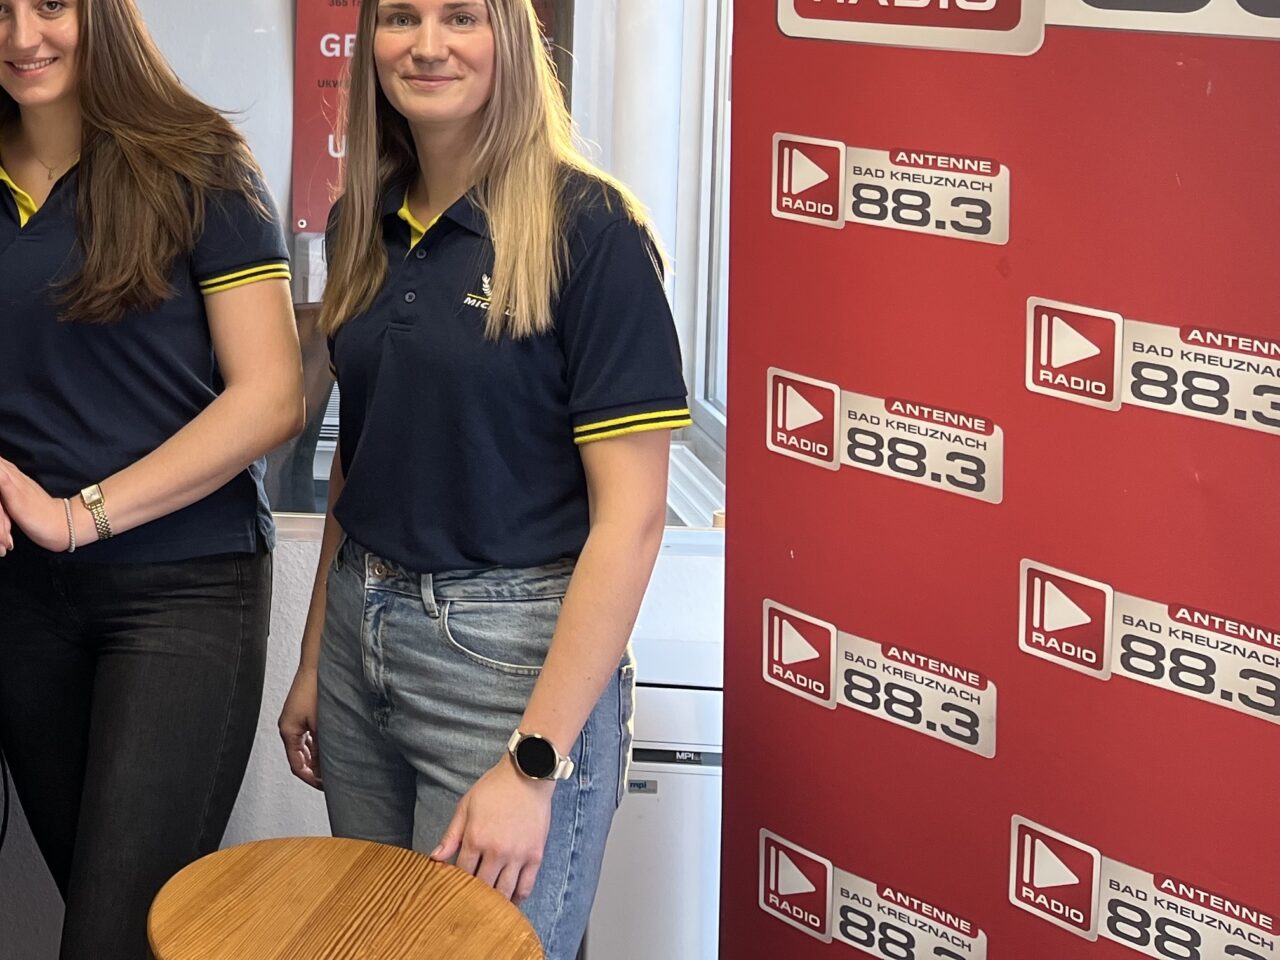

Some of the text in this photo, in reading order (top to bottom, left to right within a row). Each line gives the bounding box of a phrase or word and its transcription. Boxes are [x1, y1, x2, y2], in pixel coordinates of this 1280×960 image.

[852, 166, 993, 193] BAD KREUZNACH
[895, 151, 992, 173] ANTENNE
[782, 196, 833, 215] RADIO
[851, 183, 993, 236] 88.3
[1133, 342, 1280, 378] BAD KREUZNA
[1039, 369, 1106, 396] RADIO
[1131, 361, 1280, 428] 88.3
[847, 410, 987, 451] BAD KREUZNACH
[891, 401, 986, 431] ANTENNE
[776, 432, 828, 456] RADIO
[846, 427, 986, 493] 88.3
[1122, 614, 1162, 633] BAD
[887, 646, 980, 686] ANTENNE
[1032, 632, 1097, 663] RADIO
[772, 665, 824, 695] RADIO
[844, 651, 981, 705] BAD KREUZNACH
[1120, 634, 1280, 716] 88.3
[843, 668, 980, 746] 88.3
[768, 895, 821, 928] RADIO
[840, 886, 972, 952] BAD KREUZNACH
[882, 886, 972, 933] ANTENNE
[1021, 886, 1084, 923] RADIO
[1109, 879, 1273, 951] BAD KREUZNACH
[1161, 879, 1272, 930] ANTENNE
